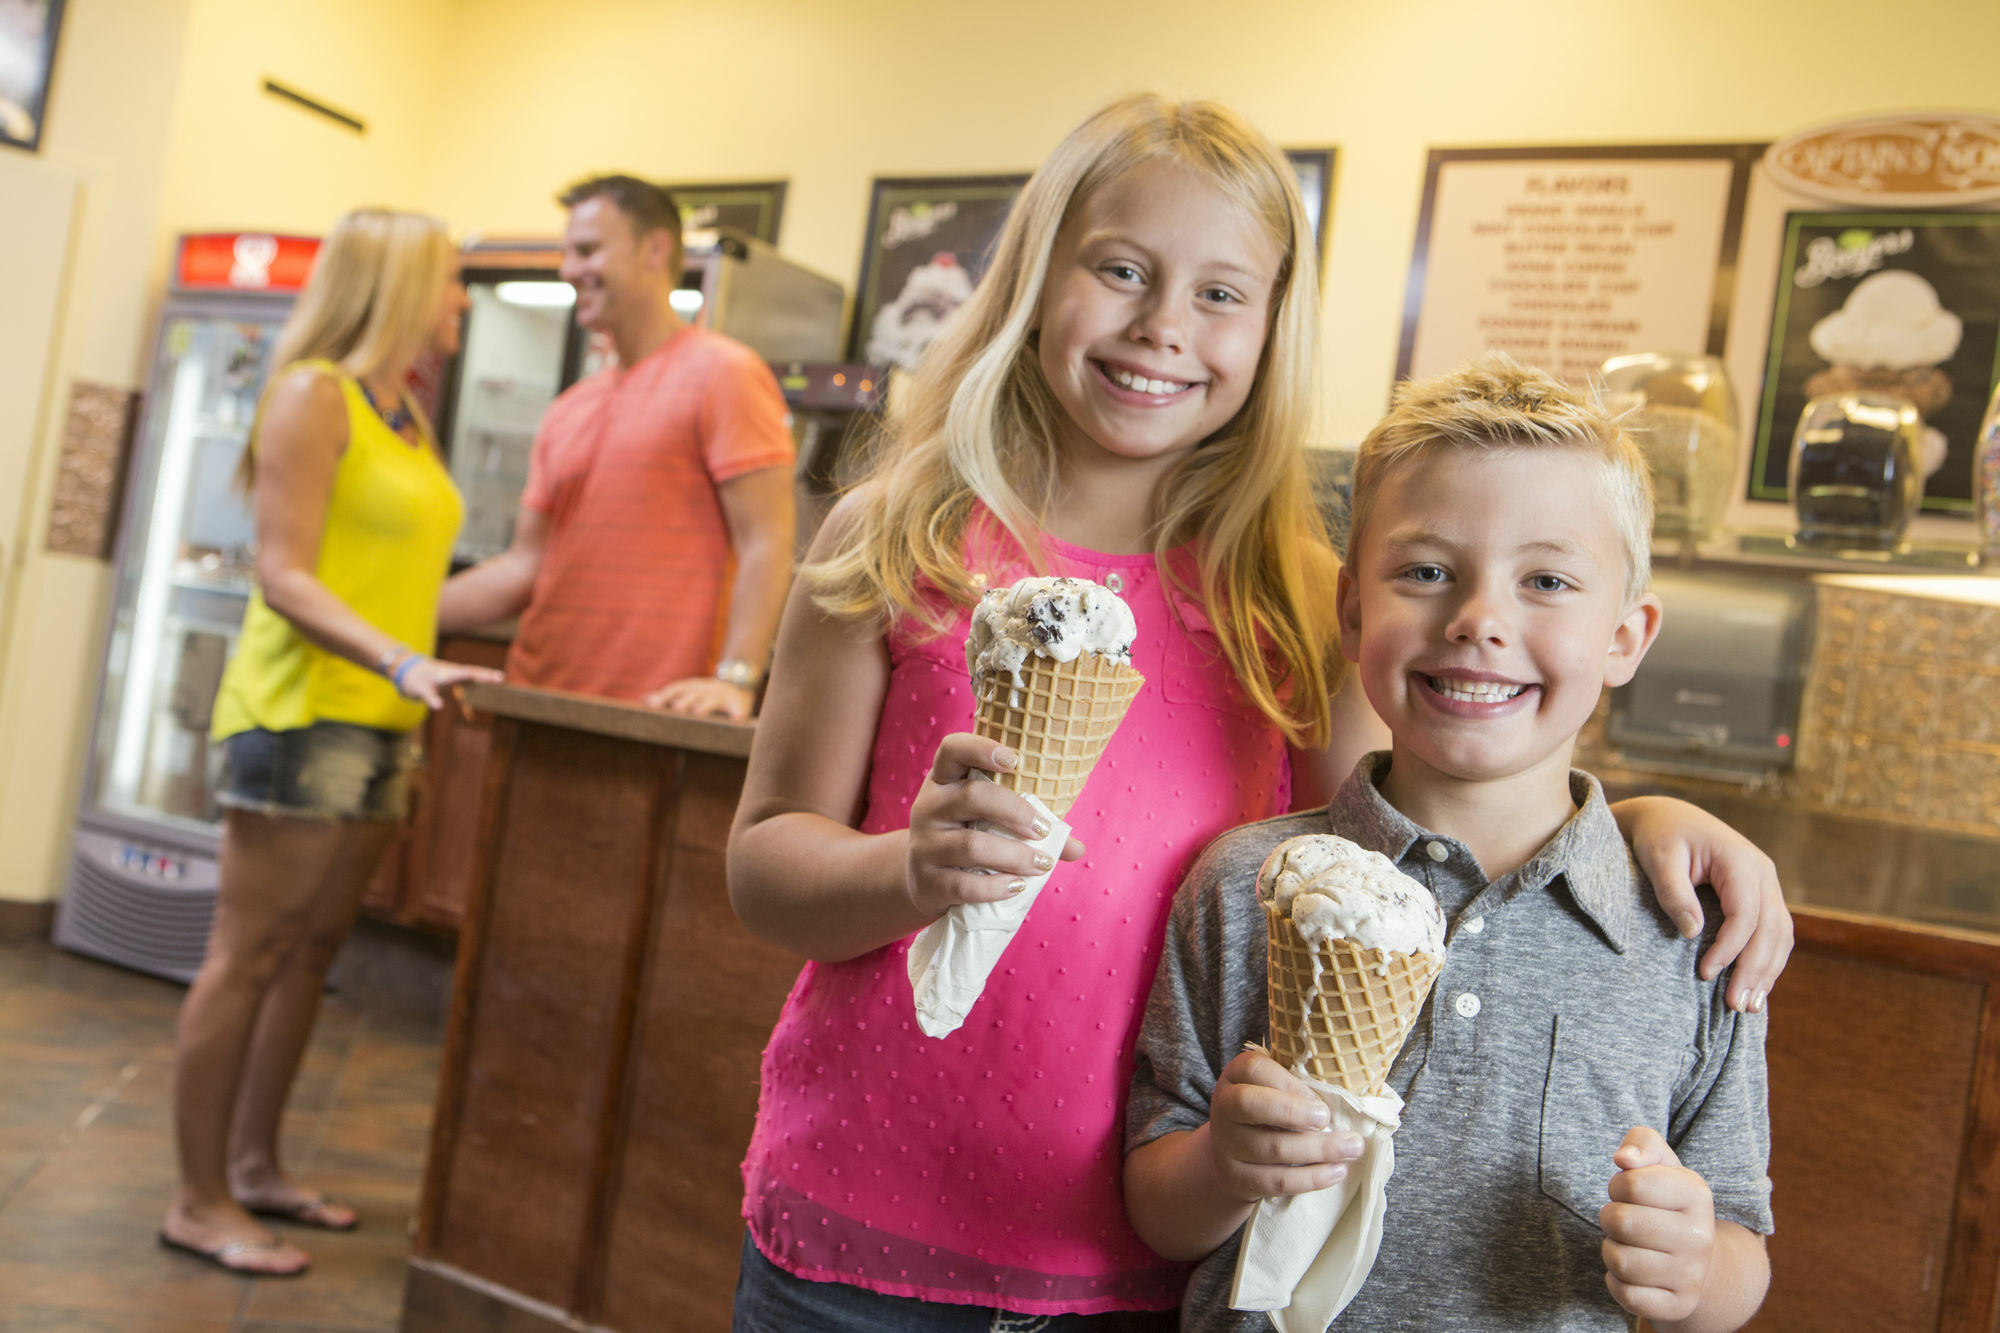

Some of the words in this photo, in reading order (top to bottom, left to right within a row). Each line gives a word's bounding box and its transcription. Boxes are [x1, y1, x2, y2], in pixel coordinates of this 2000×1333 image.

[1938, 141, 2000, 173] NO
[1525, 175, 1630, 197] FLAVORS
[1573, 202, 1646, 219] VANILLA
[1471, 221, 1513, 237] MINT
[1520, 221, 1623, 238] CHOCOLATE
[1632, 221, 1678, 238] CHIP
[1503, 239, 1567, 256] BUTTER
[1574, 240, 1634, 257] PECAN
[1563, 258, 1626, 276] COFFEE
[1486, 277, 1590, 294] CHOCOLATE
[1597, 279, 1641, 296] CHIP
[1507, 296, 1611, 314] CHOCOLATE
[1476, 314, 1553, 332] COOKIES
[1576, 317, 1641, 334] CREAM
[1556, 336, 1626, 354] DOUGH
